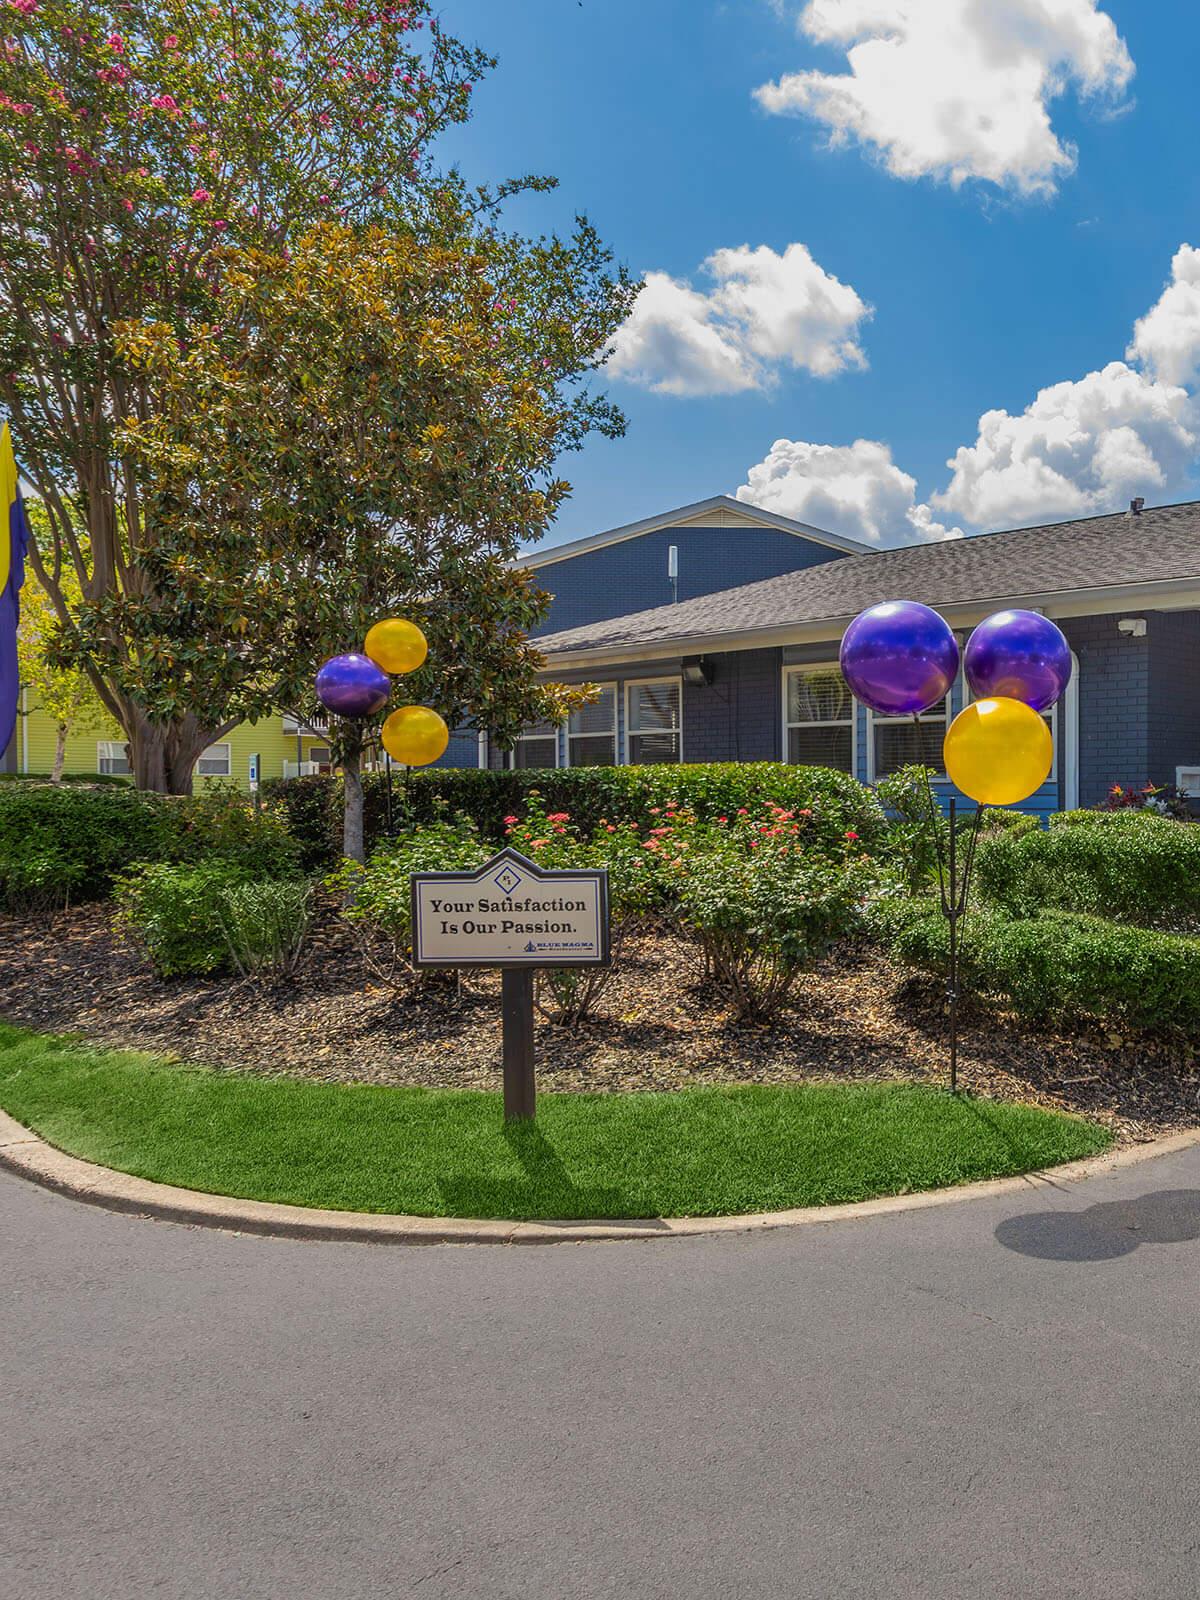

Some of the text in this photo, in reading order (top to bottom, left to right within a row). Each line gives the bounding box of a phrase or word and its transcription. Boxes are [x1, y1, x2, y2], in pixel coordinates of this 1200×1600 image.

[430, 897, 586, 913] Your Satisfaction
[440, 919, 577, 934] Is Our Passion.
